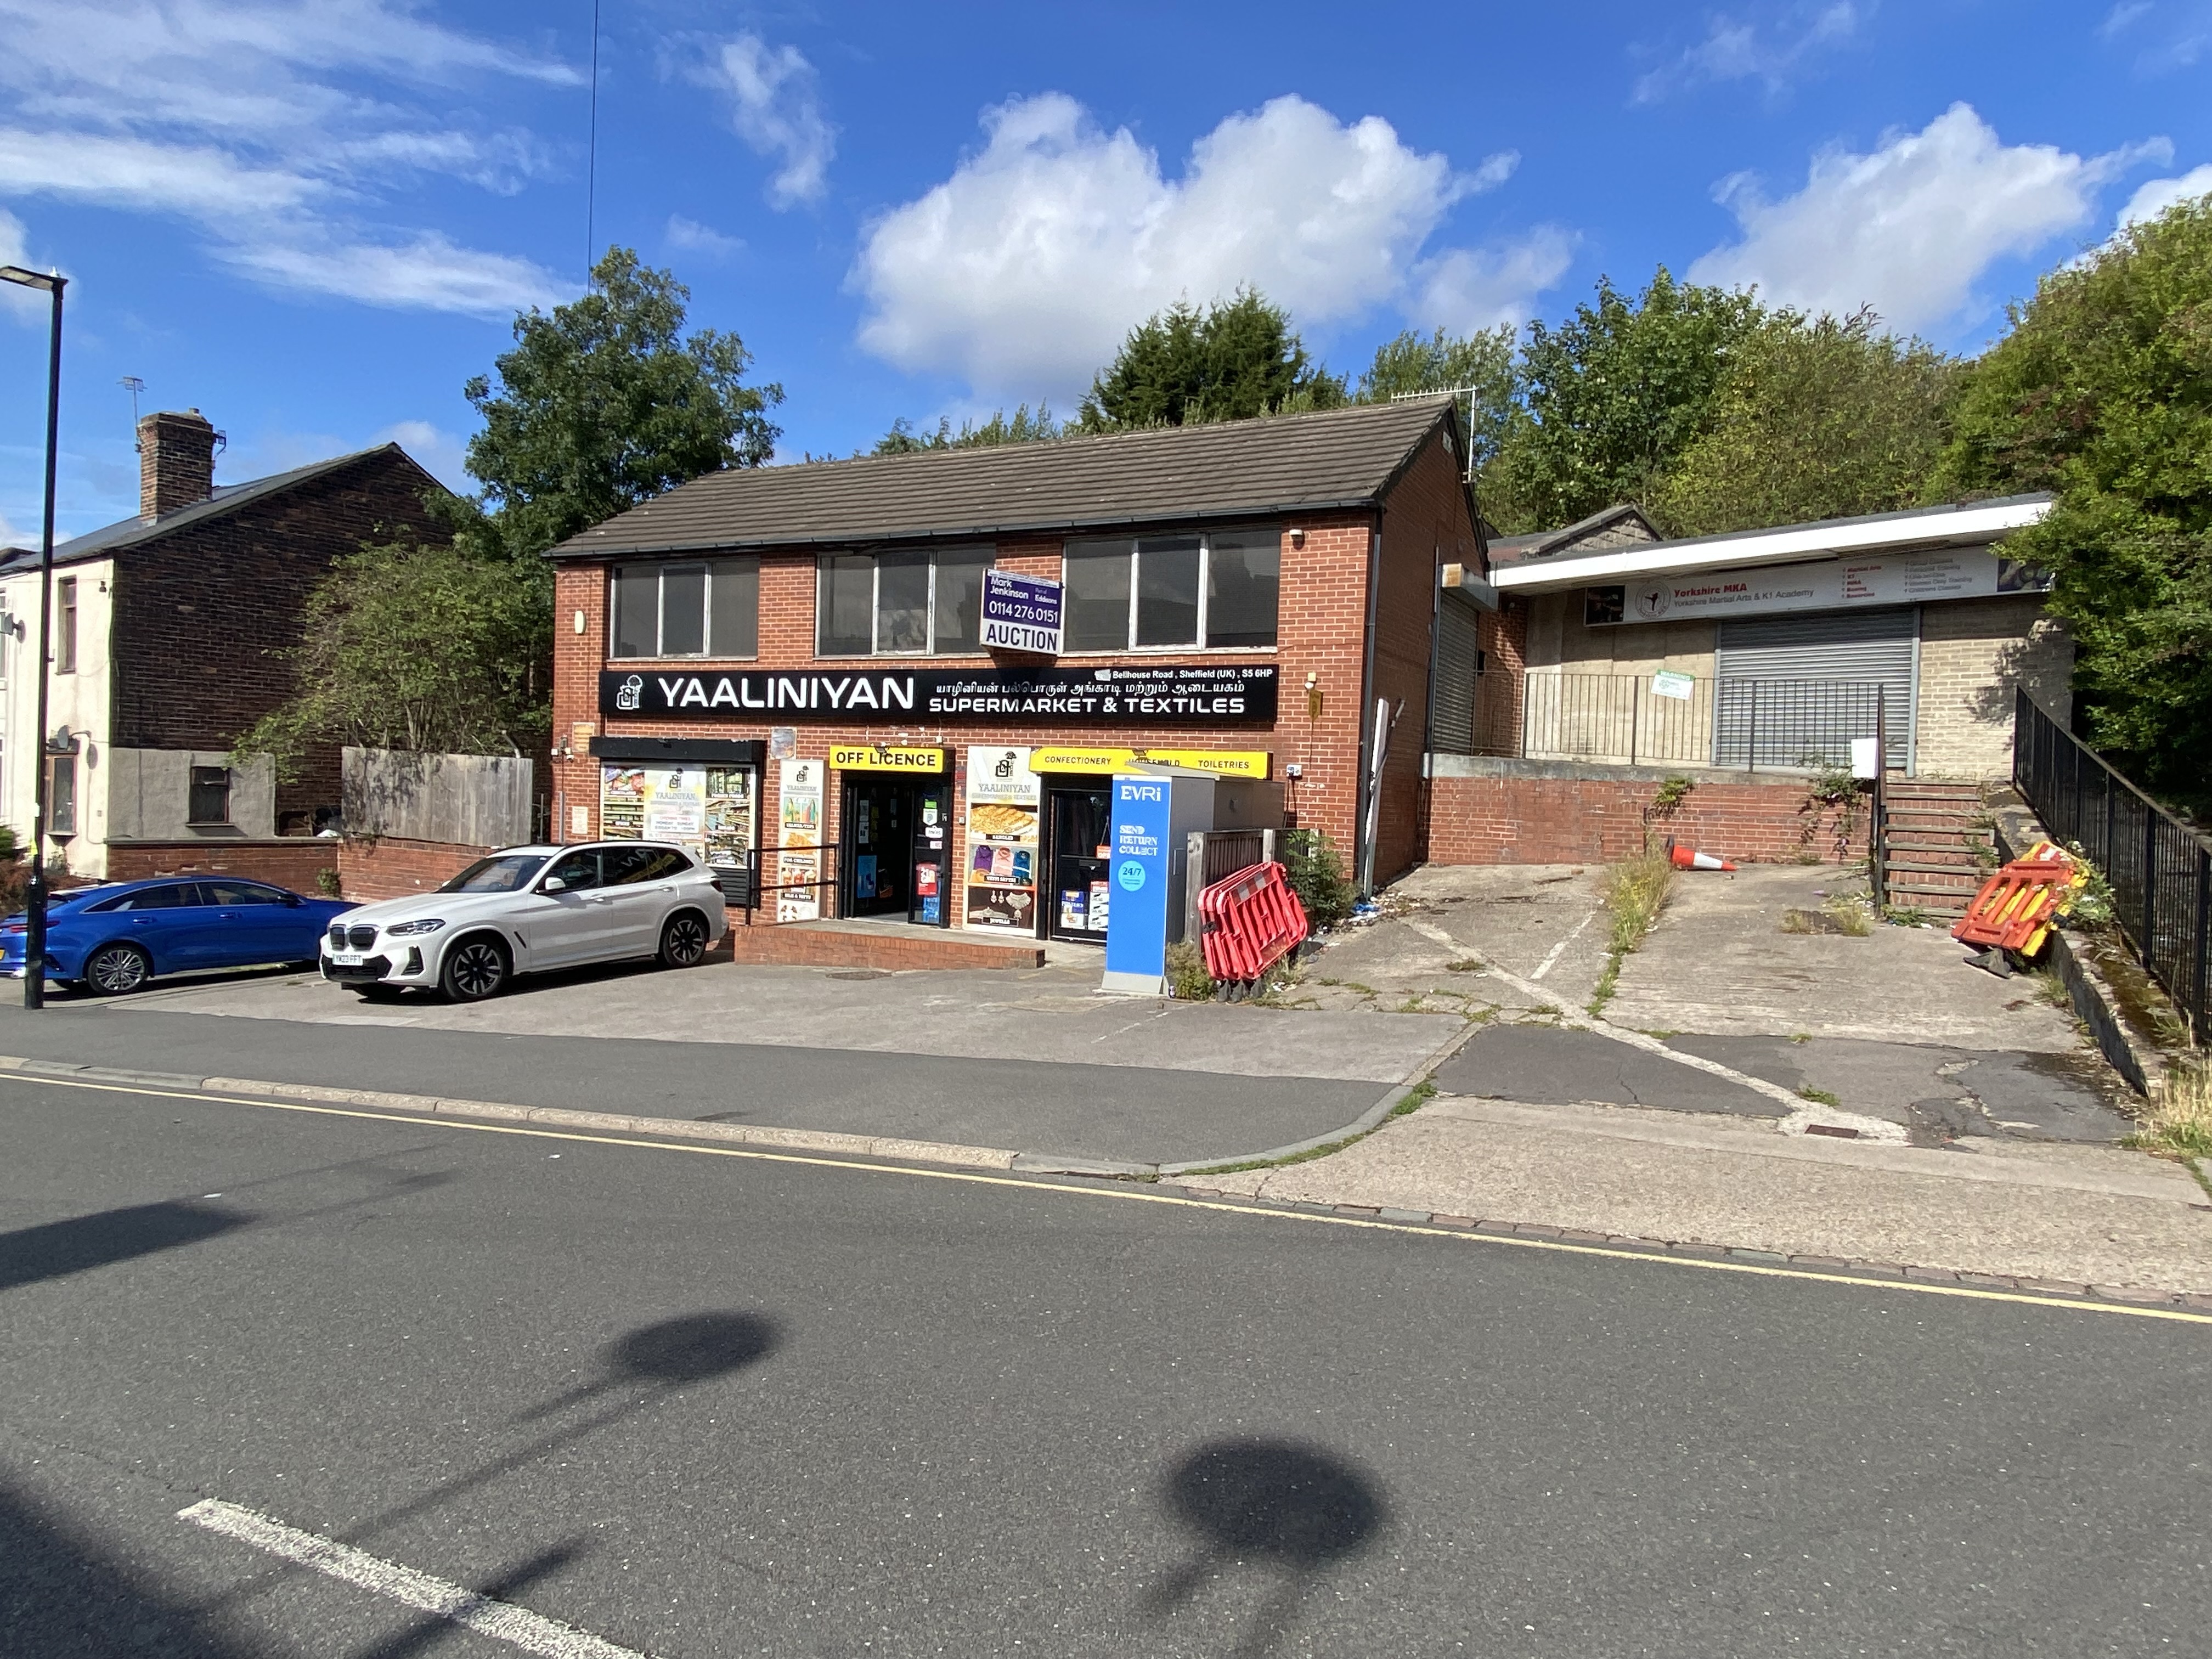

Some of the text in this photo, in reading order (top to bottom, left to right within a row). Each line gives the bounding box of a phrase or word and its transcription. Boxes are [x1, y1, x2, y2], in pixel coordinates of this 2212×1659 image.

[991, 577, 1012, 588] Mark
[990, 585, 1029, 600] Jenkinson
[1674, 586, 1720, 597] Yorkshire
[1709, 595, 1735, 604] Martial
[1776, 589, 1814, 599] Academy
[989, 601, 1058, 623] 0114 276 0151
[986, 624, 1057, 651] AUCTION
[1113, 670, 1151, 679] Bellhouse
[1180, 670, 1215, 678] Sheffield
[1217, 669, 1235, 679] (UK)
[1242, 669, 1253, 678] S5
[1255, 669, 1273, 678] 6HP
[658, 677, 913, 709] YAALINIYAN
[929, 697, 1245, 713] SUPERMARKET & TEXTILES
[836, 752, 936, 767] OFF LICENCE
[1045, 756, 1250, 769] CONFECTIONERY TOILETRIES
[978, 783, 1031, 793] YAALINIYAN
[1120, 825, 1145, 834] SEND
[1120, 836, 1158, 845] RETURN
[1119, 845, 1158, 856] COLLECT
[1122, 867, 1142, 876] 24/7
